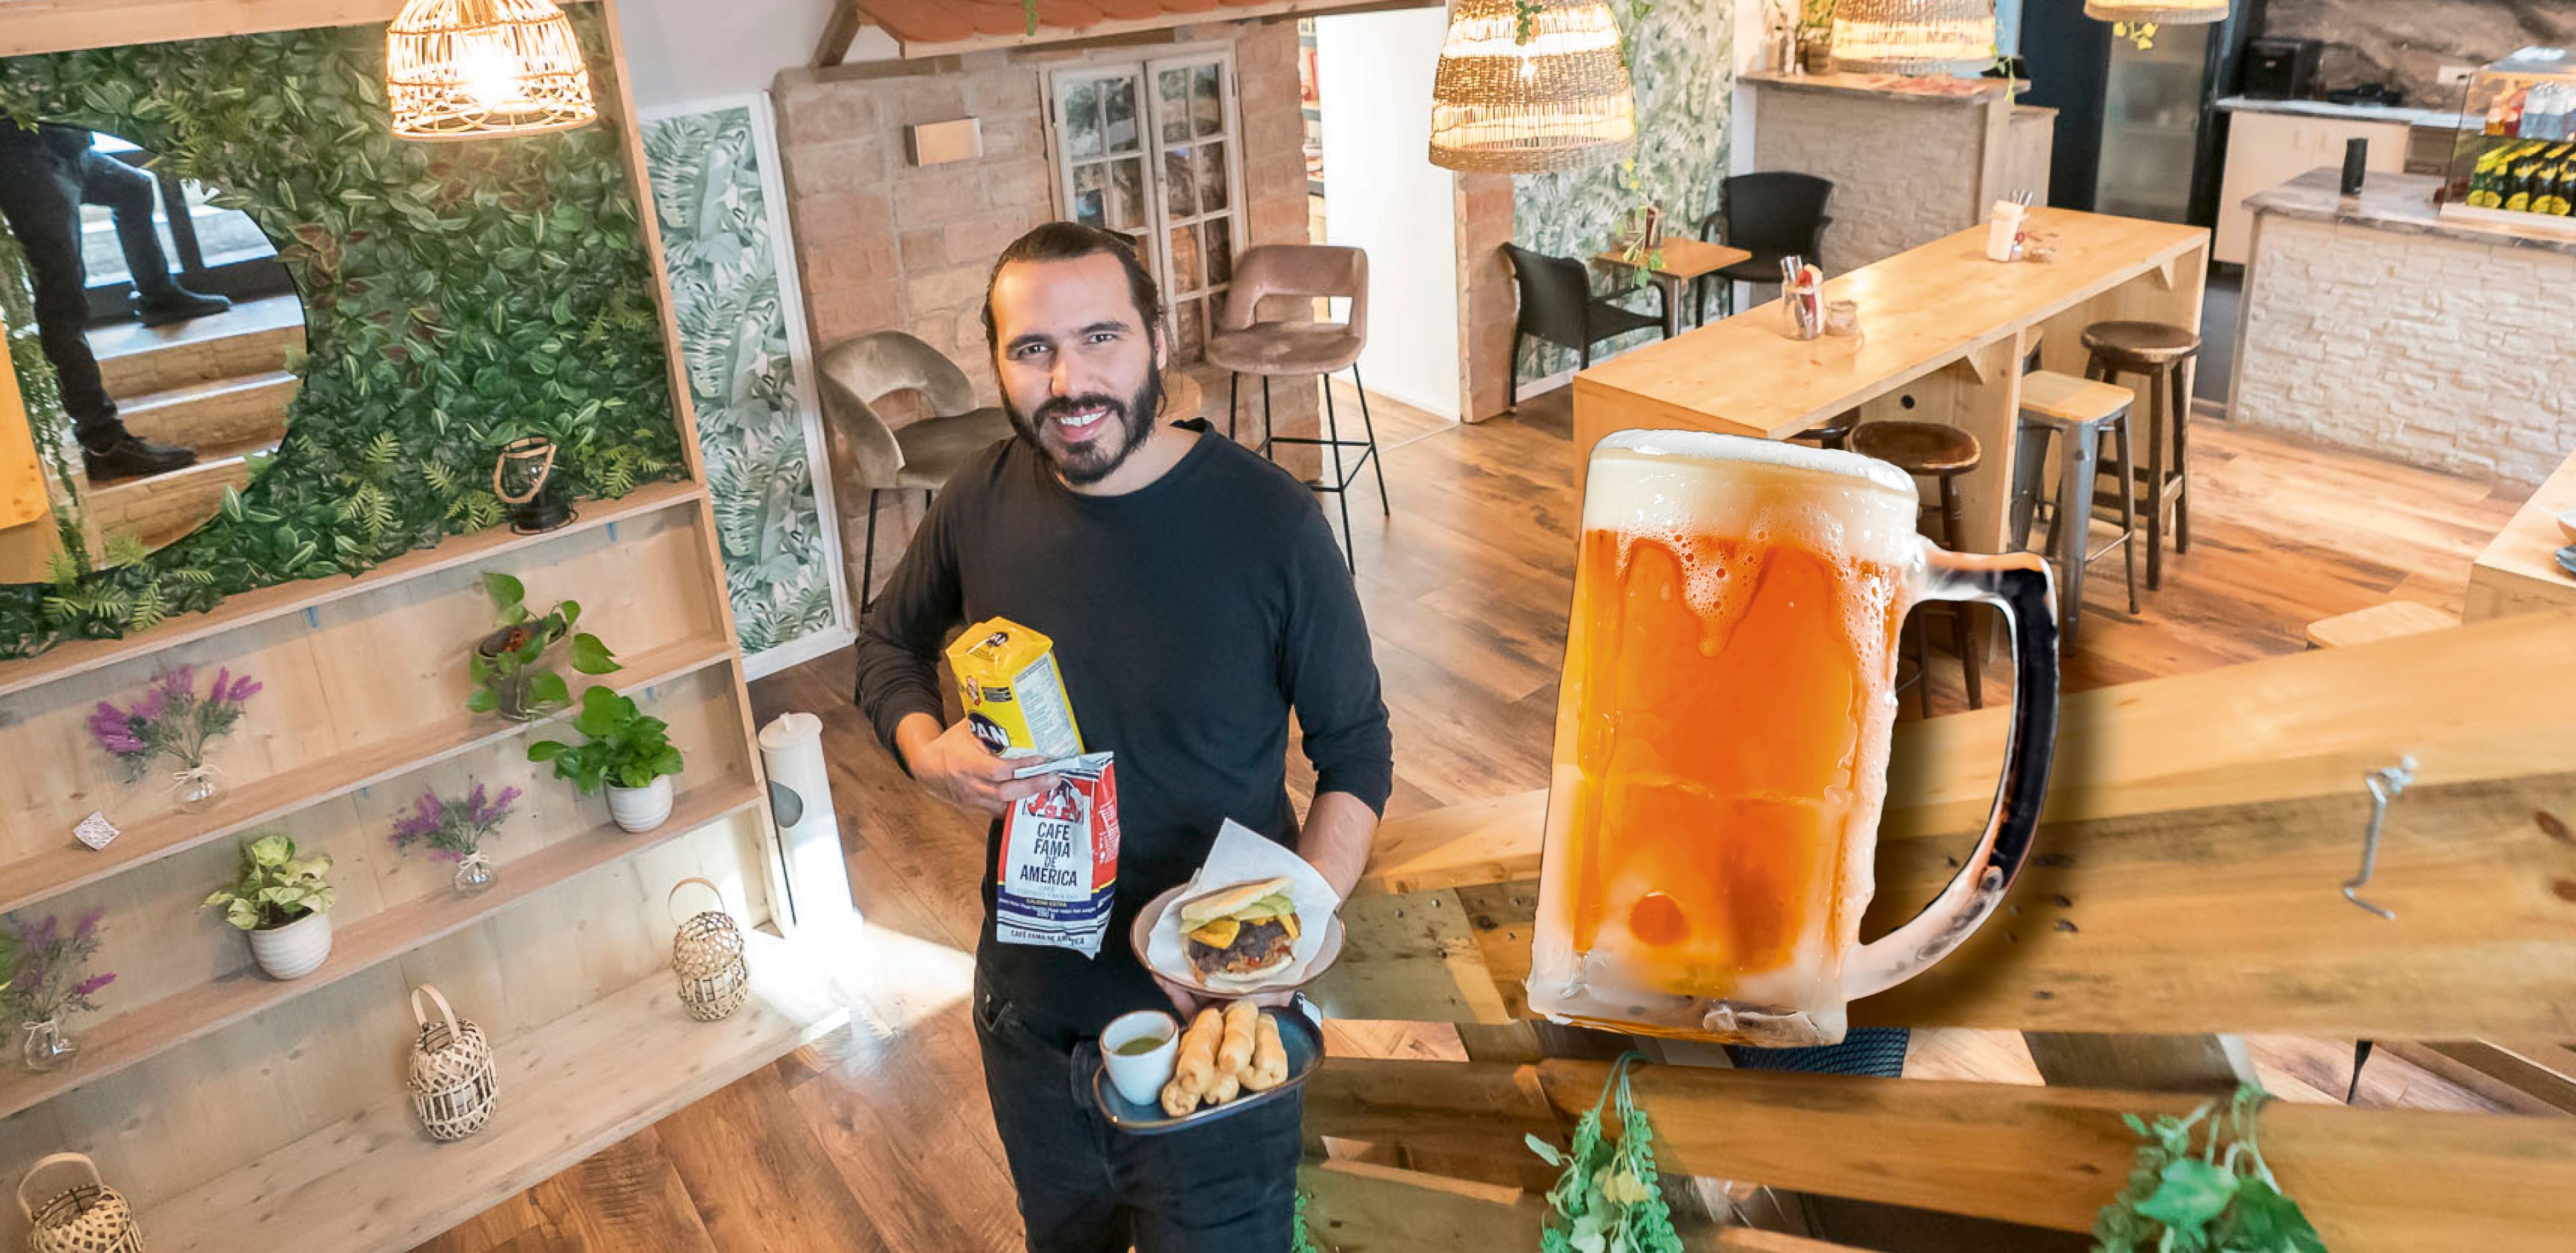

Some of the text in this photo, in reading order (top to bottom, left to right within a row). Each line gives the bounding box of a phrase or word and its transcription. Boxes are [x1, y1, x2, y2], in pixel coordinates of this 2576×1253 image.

[1037, 822, 1070, 840] CAFE
[1034, 838, 1070, 858] FAMA
[1044, 856, 1057, 868] DE
[1020, 864, 1077, 886] AMERICA
